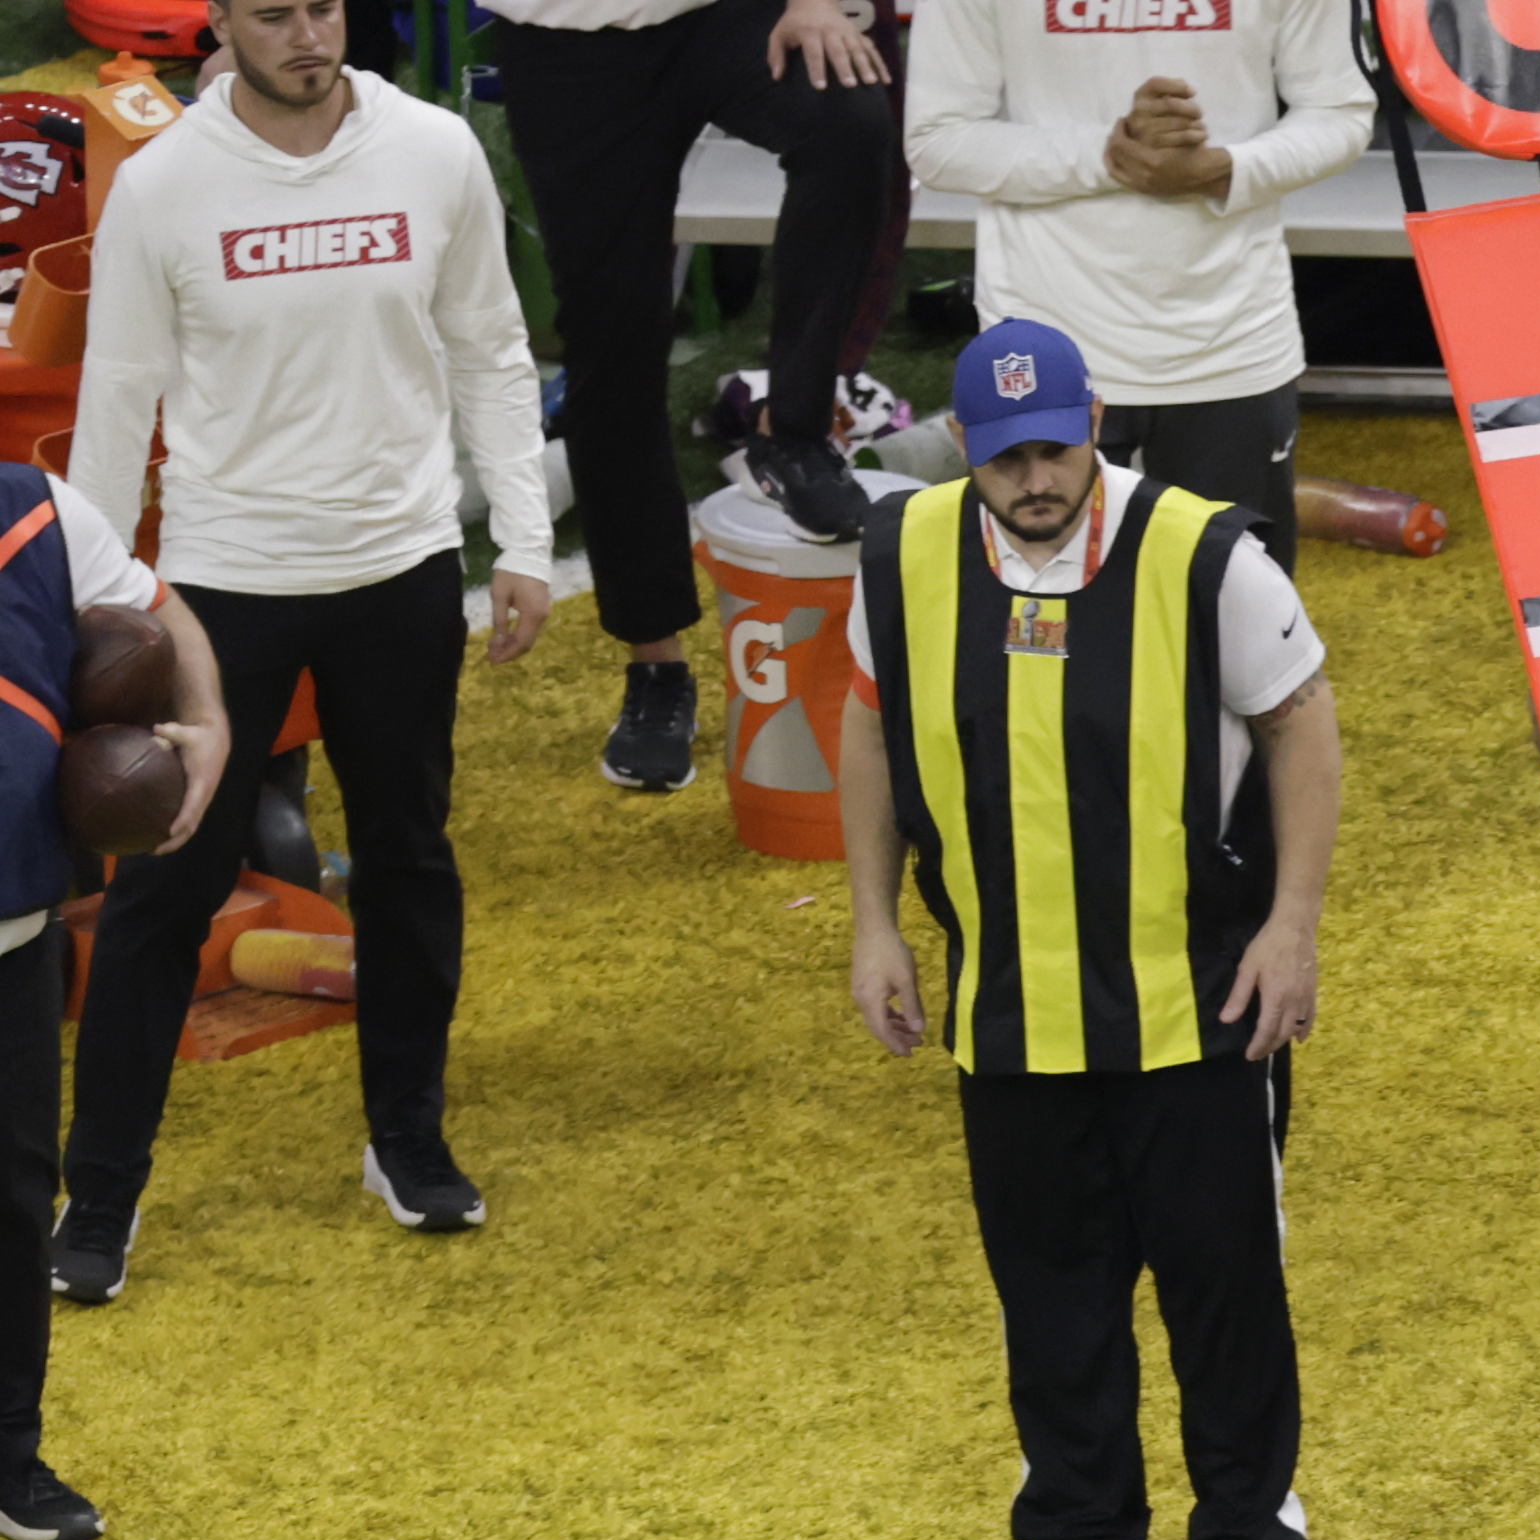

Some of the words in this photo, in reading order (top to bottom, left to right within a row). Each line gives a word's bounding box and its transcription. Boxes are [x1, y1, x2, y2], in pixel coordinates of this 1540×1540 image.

[1055, 0, 1217, 29] CHIEFS
[233, 216, 399, 274] CHIEFS
[730, 619, 788, 704] G
